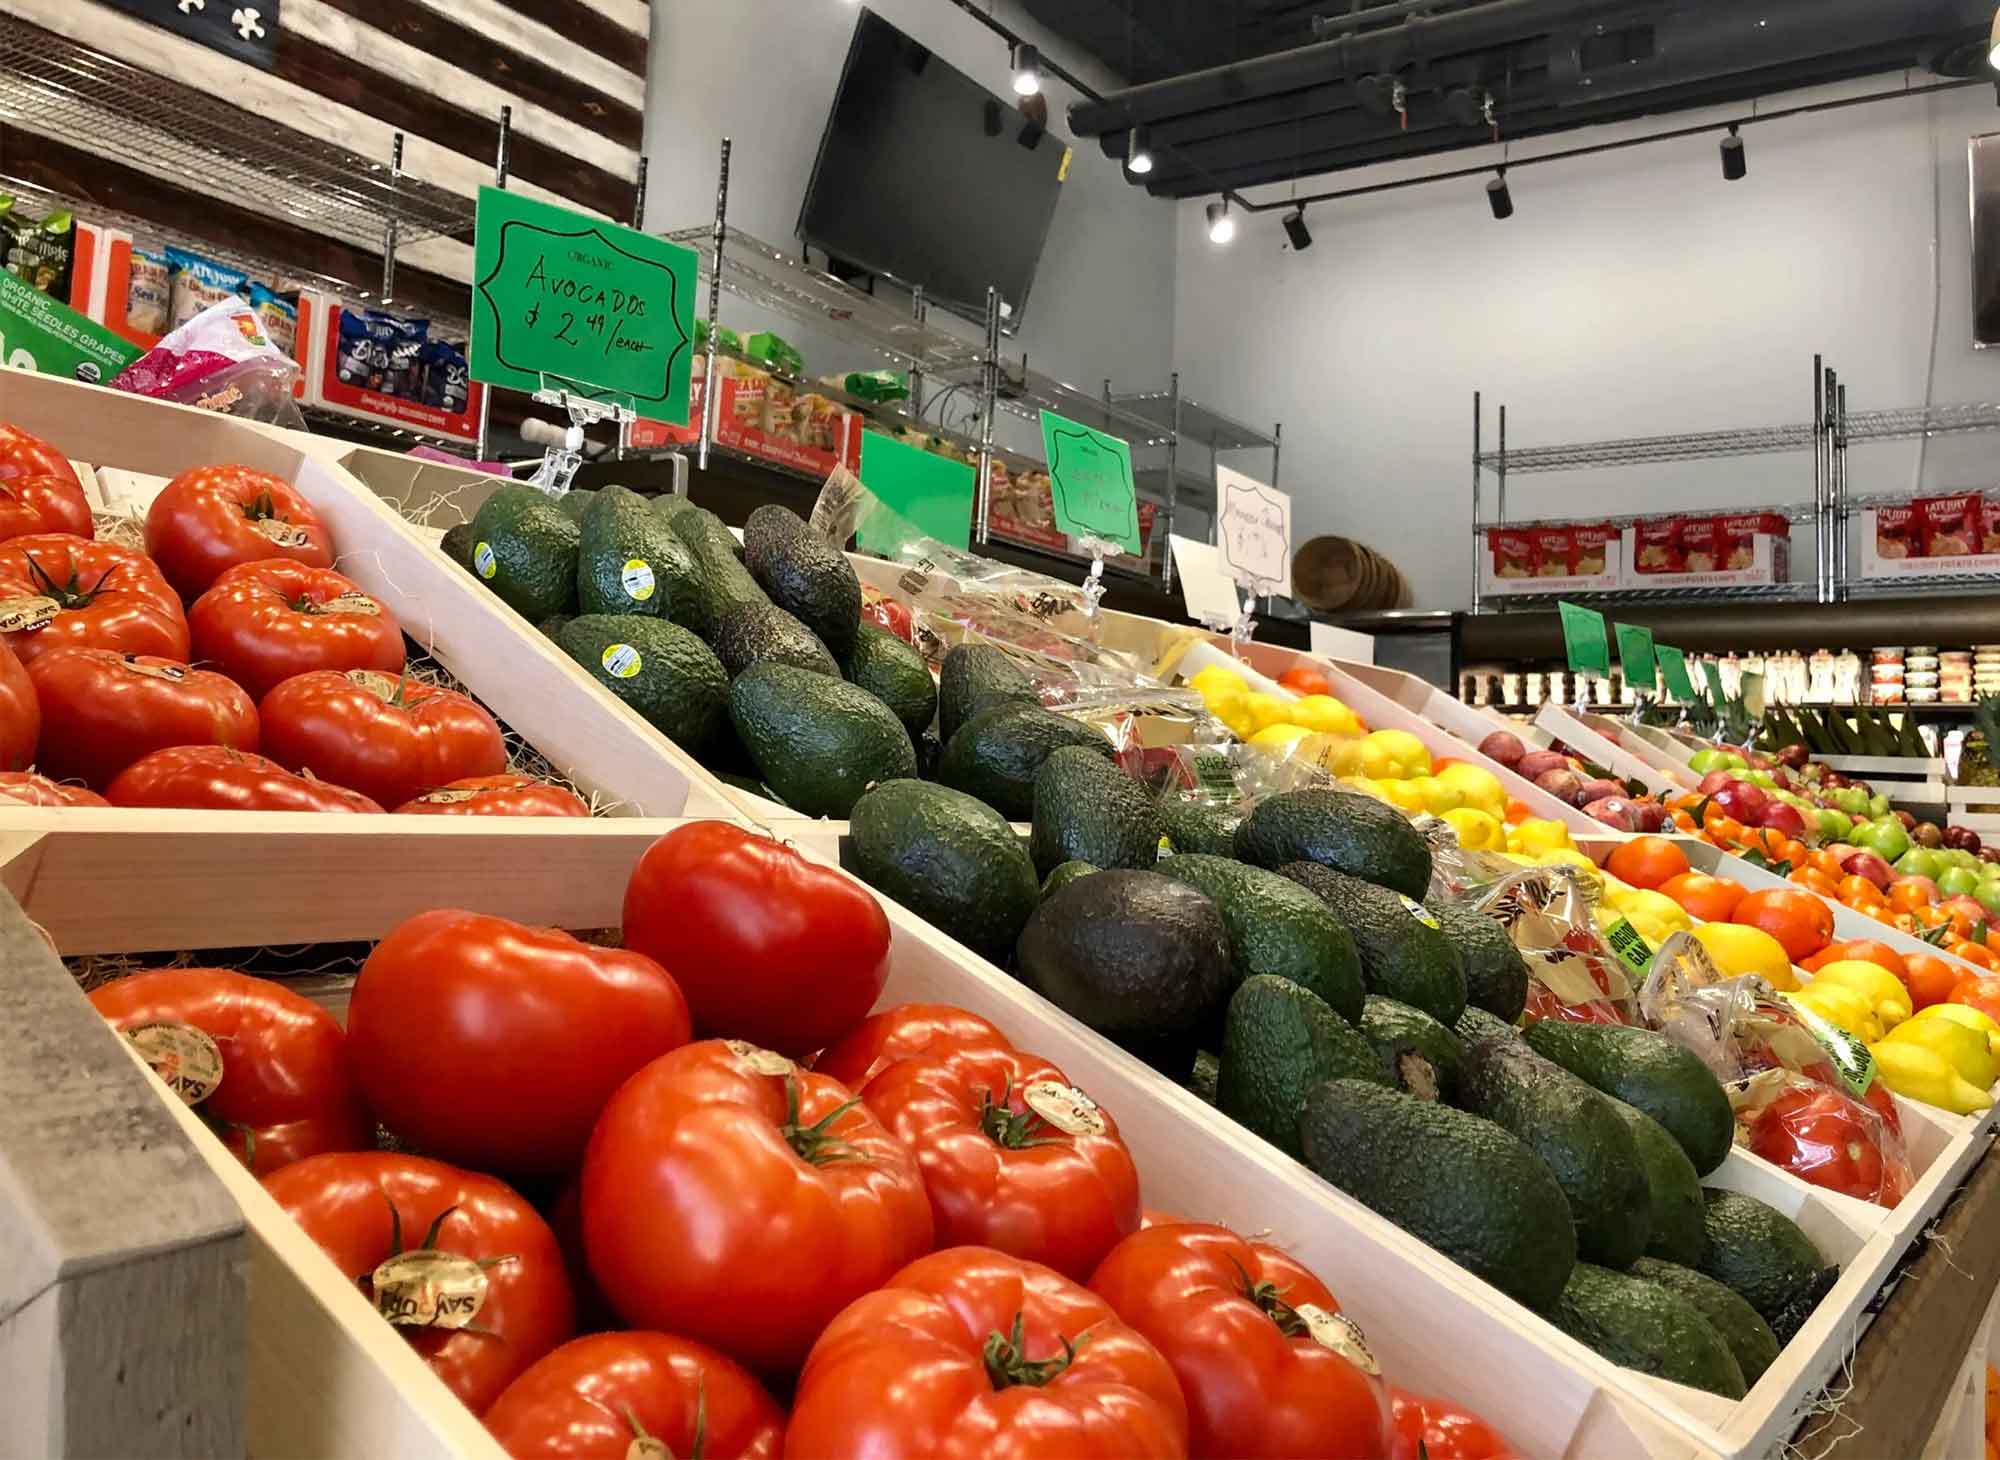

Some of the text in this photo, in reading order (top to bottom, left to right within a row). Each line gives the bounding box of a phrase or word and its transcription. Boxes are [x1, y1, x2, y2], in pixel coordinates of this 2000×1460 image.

[568, 251, 614, 270] ORGANIC
[3, 277, 51, 312] ORGANIC
[526, 254, 645, 317] AVOCADOS
[31, 305, 80, 339] SEEDLES
[79, 334, 127, 366] GRAPES
